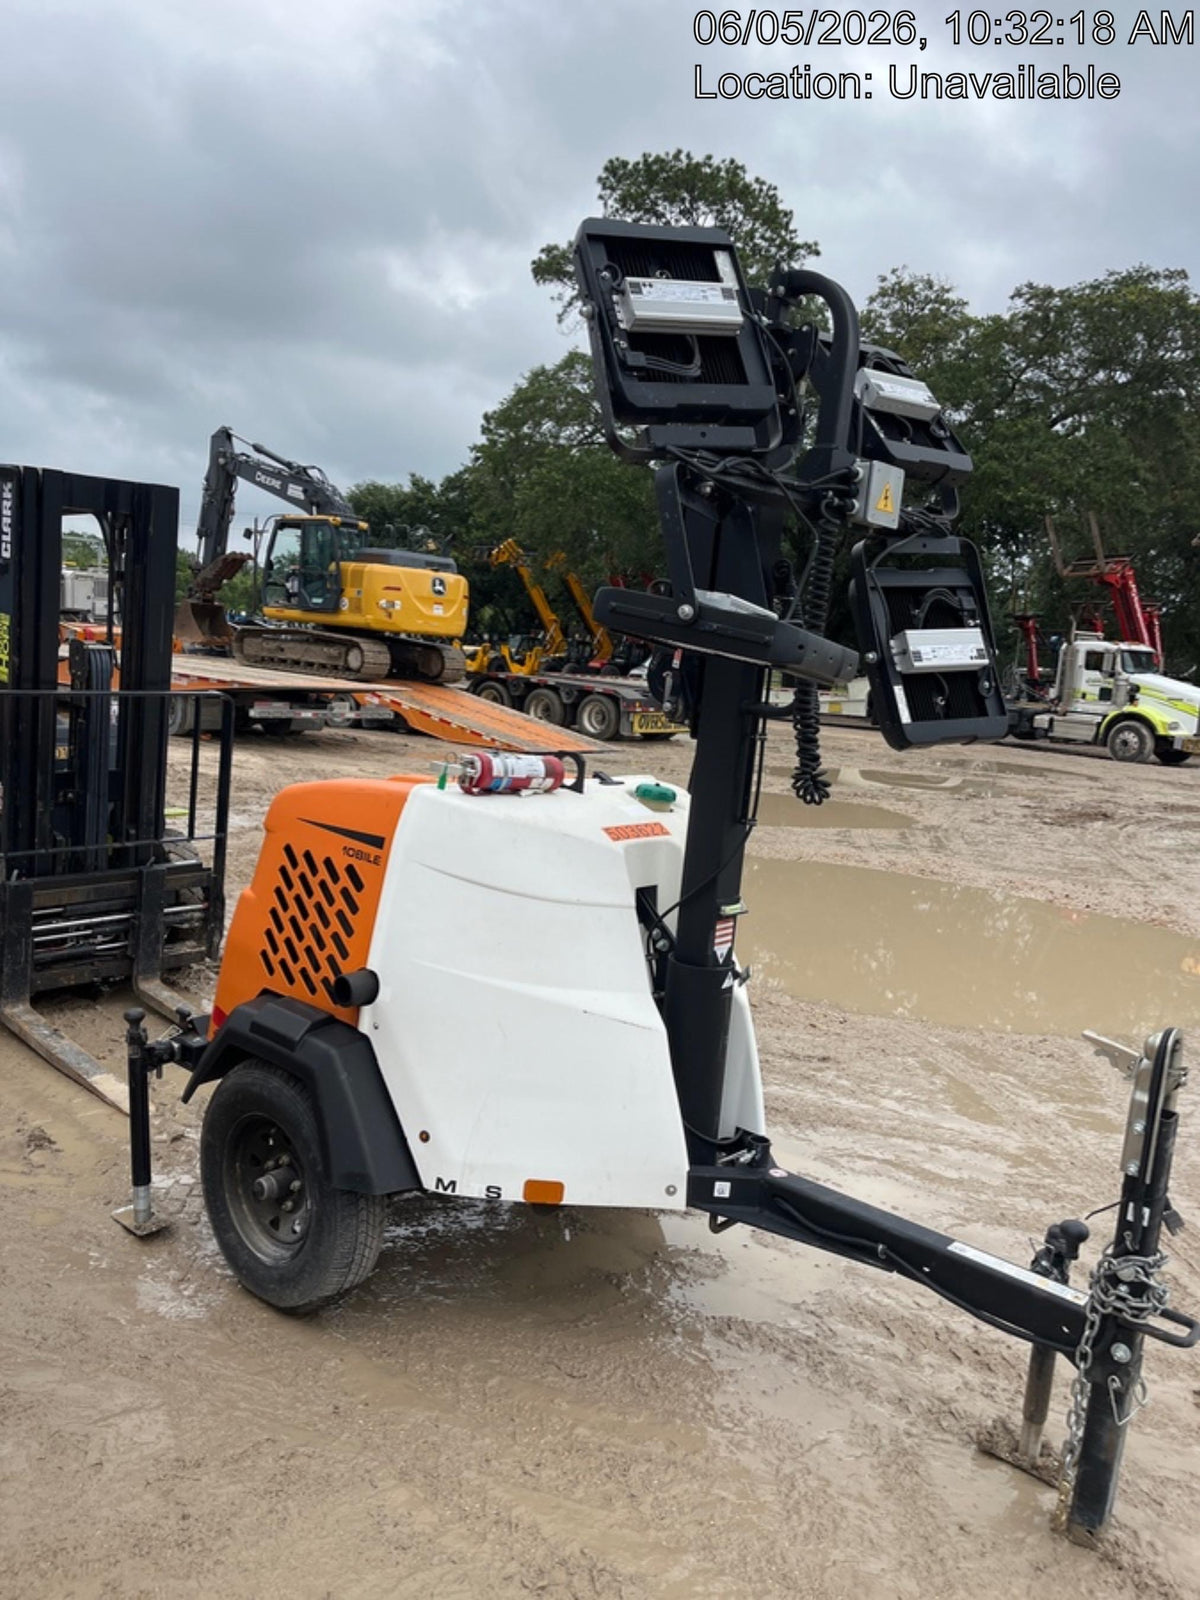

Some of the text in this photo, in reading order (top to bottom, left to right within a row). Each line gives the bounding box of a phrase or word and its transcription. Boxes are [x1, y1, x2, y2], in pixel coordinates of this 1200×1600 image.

[255, 471, 281, 489] DEERE
[1, 481, 12, 558] CLARK
[435, 1176, 502, 1199] M S
